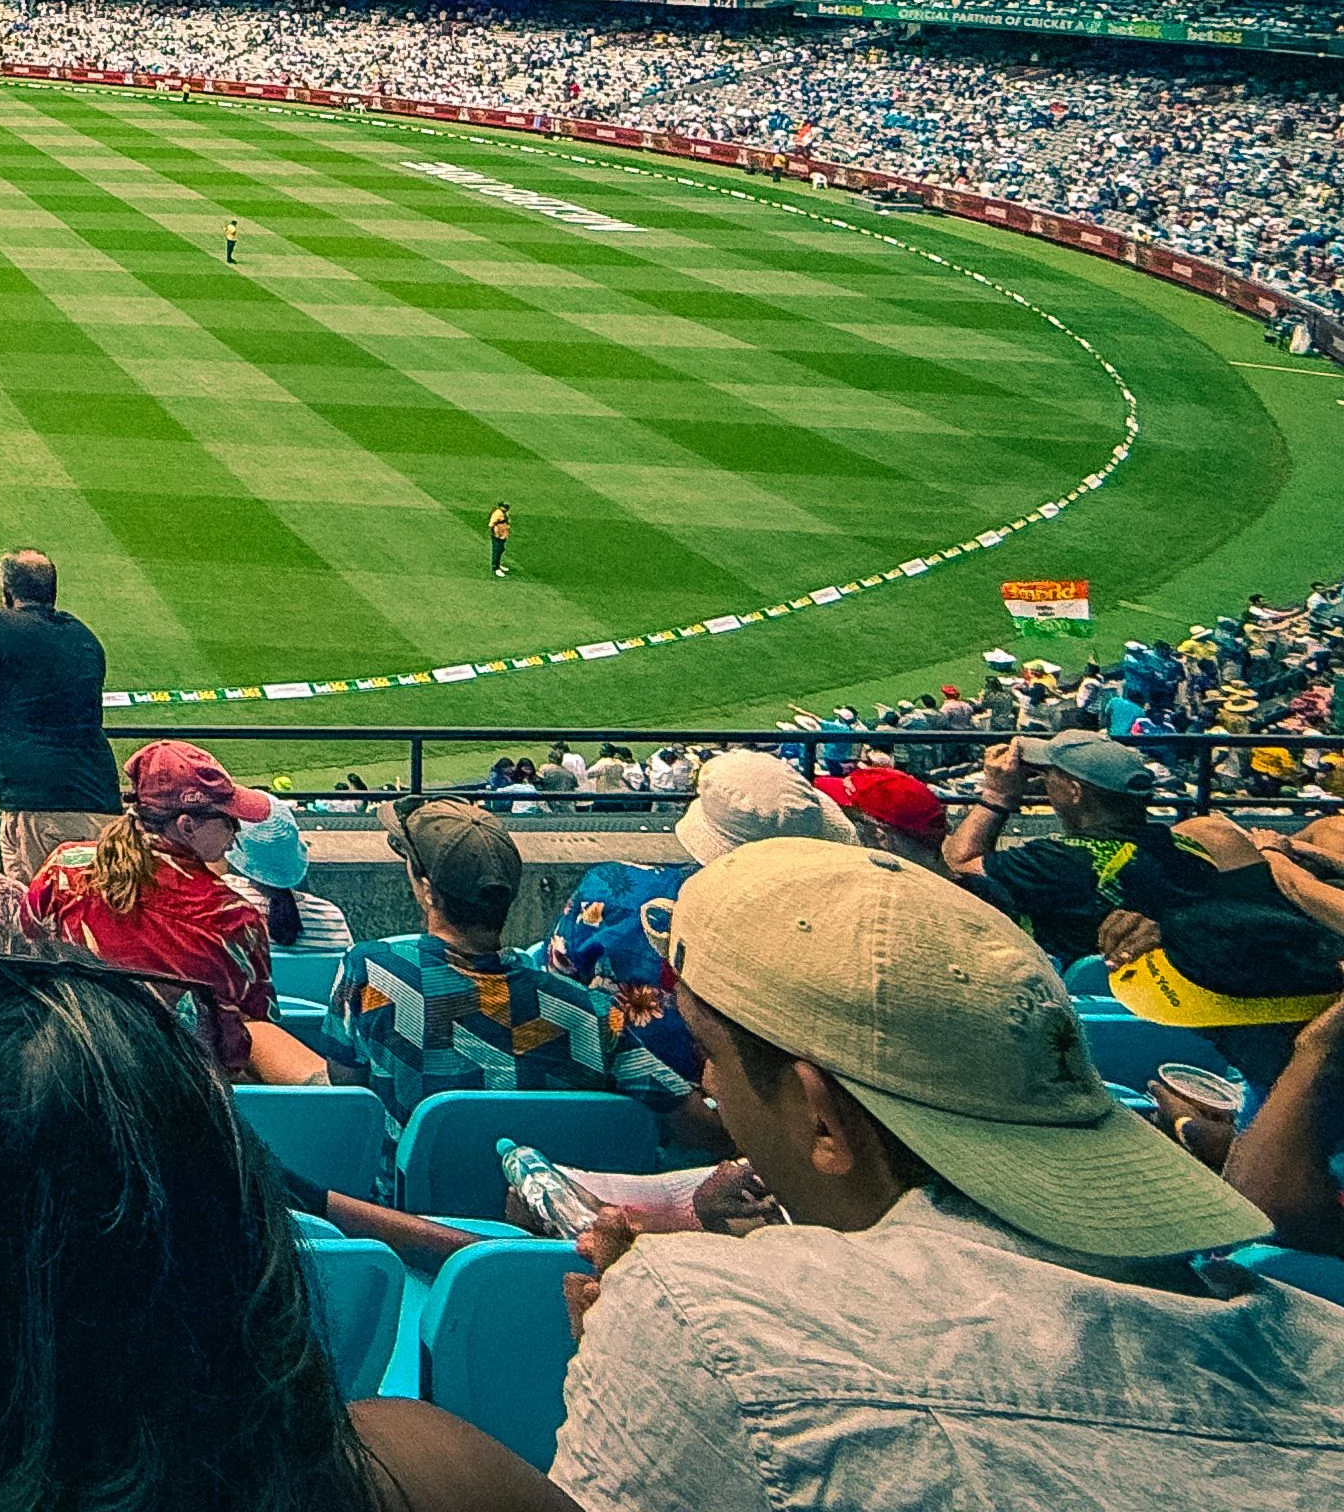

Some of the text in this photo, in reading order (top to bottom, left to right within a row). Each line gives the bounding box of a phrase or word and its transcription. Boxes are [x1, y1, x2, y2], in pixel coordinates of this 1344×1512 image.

[818, 3, 863, 16] bet365
[952, 12, 1002, 25] PARTNER
[1005, 16, 1021, 26] OF
[1023, 18, 1073, 30] CRICKET
[1187, 28, 1243, 43] bet365
